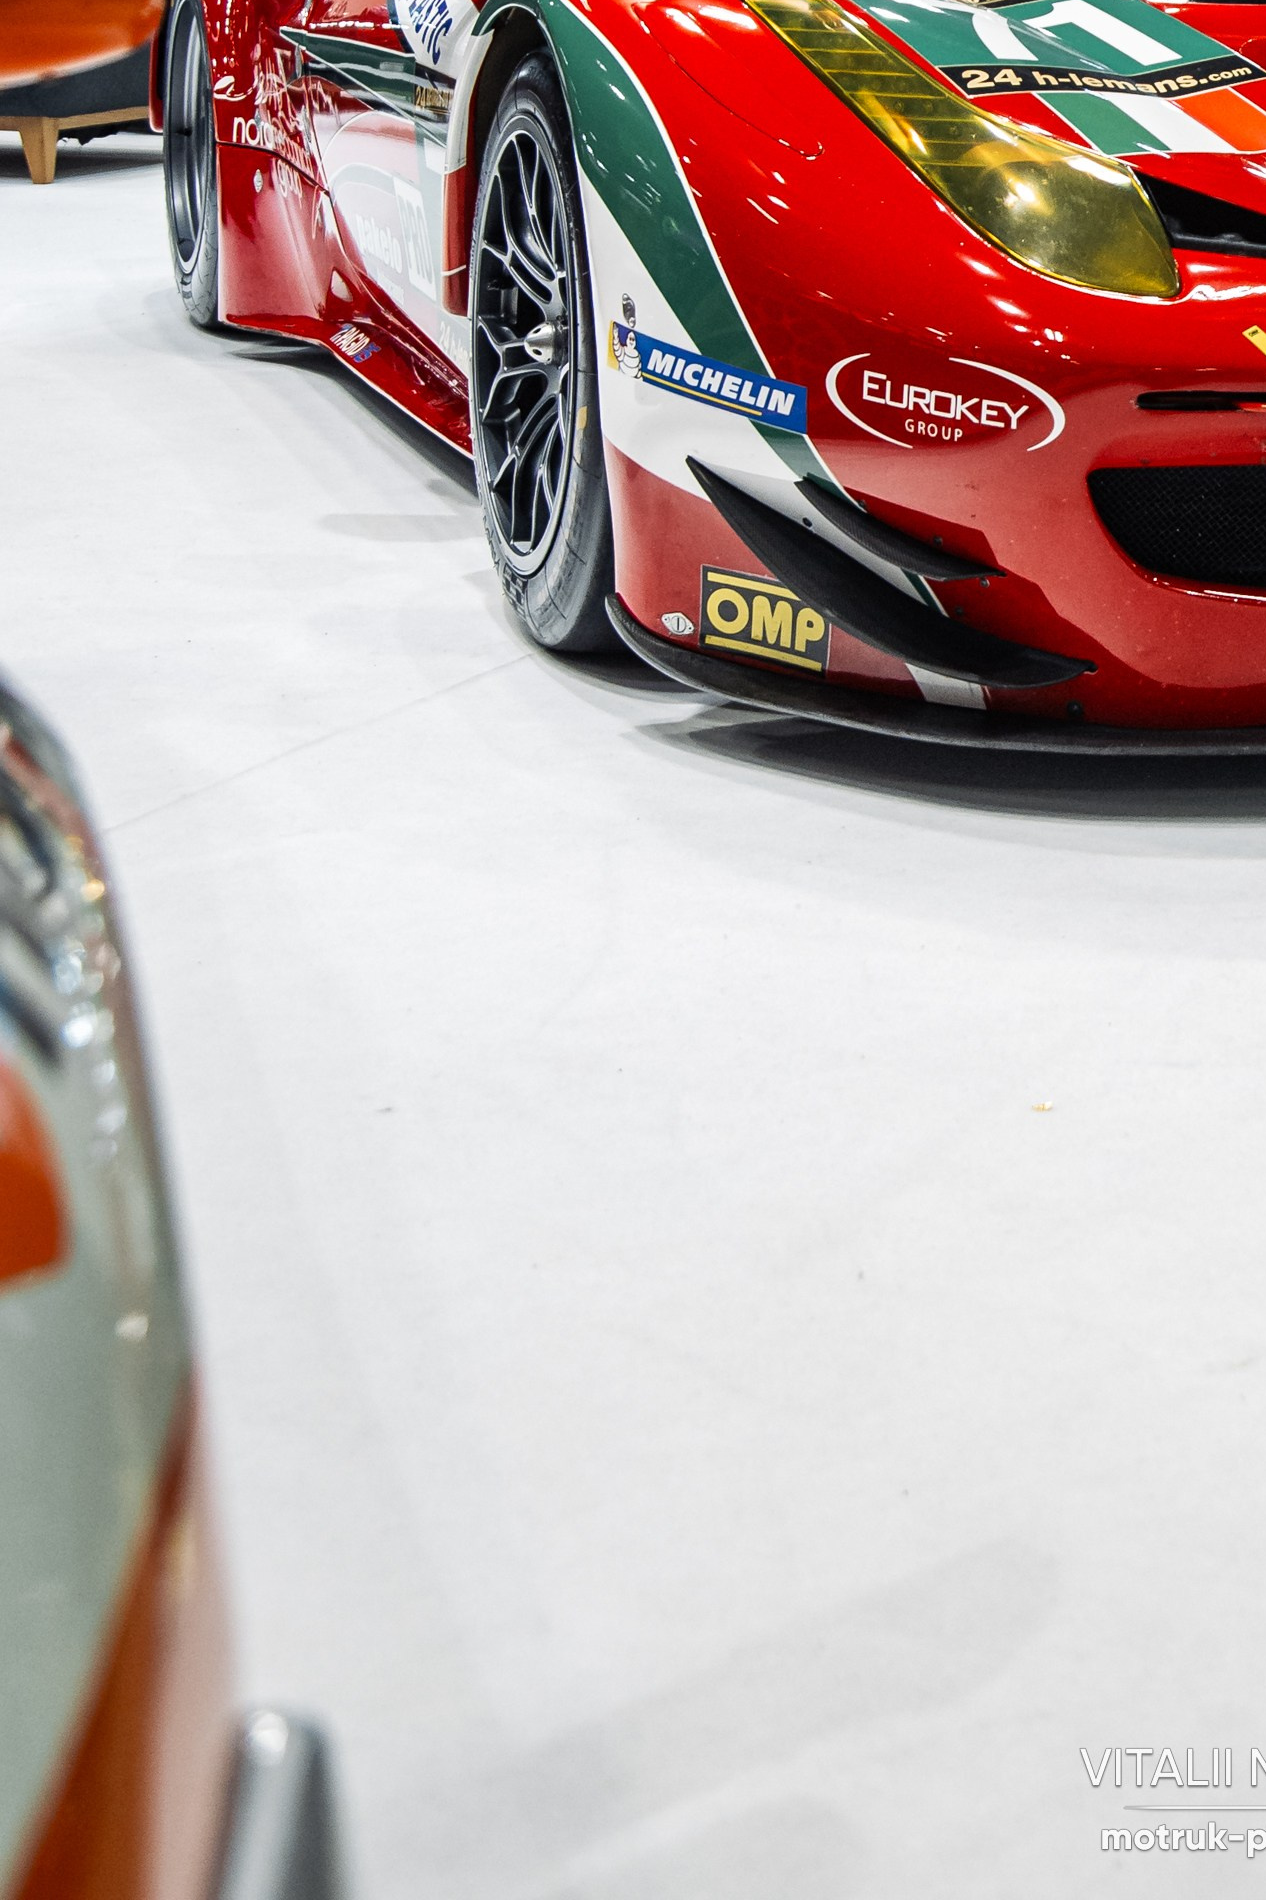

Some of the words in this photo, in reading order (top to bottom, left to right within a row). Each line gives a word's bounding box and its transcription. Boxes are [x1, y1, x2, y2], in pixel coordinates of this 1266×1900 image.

[961, 68, 1023, 89] 24
[1031, 65, 1253, 94] h-lemans.com
[646, 347, 796, 417] MICHELIN
[861, 369, 1030, 431] EUROKEY
[904, 418, 964, 442] GROUP
[706, 587, 826, 653] OMP
